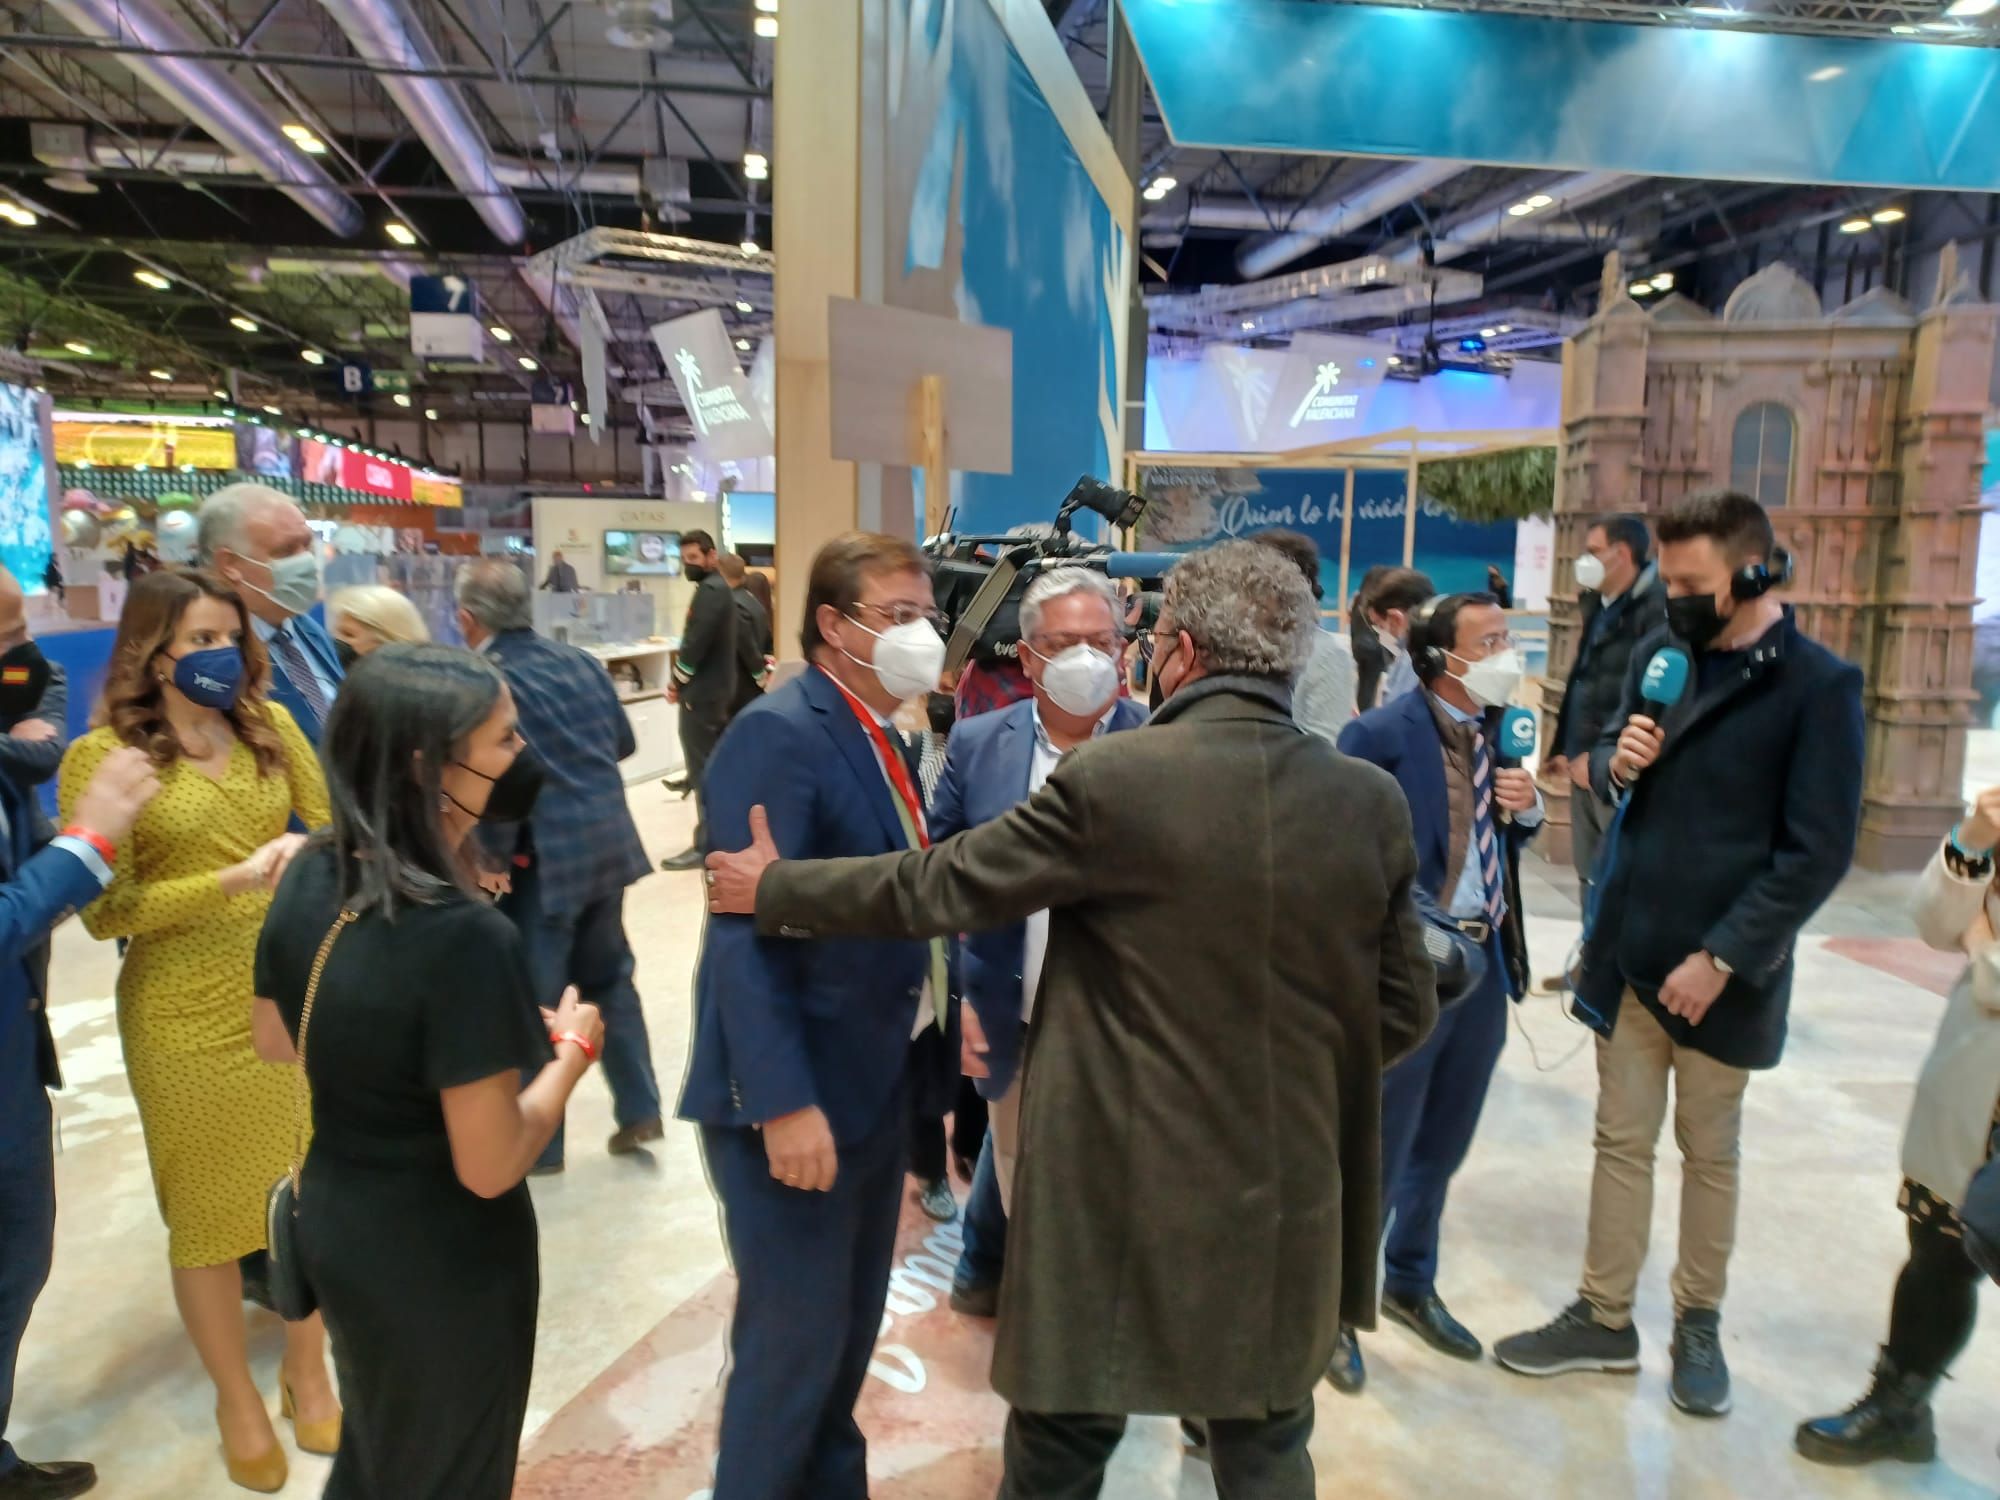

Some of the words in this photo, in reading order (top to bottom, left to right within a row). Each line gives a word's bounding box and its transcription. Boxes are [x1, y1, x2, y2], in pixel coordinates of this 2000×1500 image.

[442, 275, 466, 312] 7
[343, 365, 362, 393] B
[1304, 407, 1356, 420] VALENCIANA
[1220, 494, 1295, 537] Quien
[1300, 493, 1322, 524] lo
[1358, 495, 1408, 520] vivid
[993, 640, 1018, 658] tve
